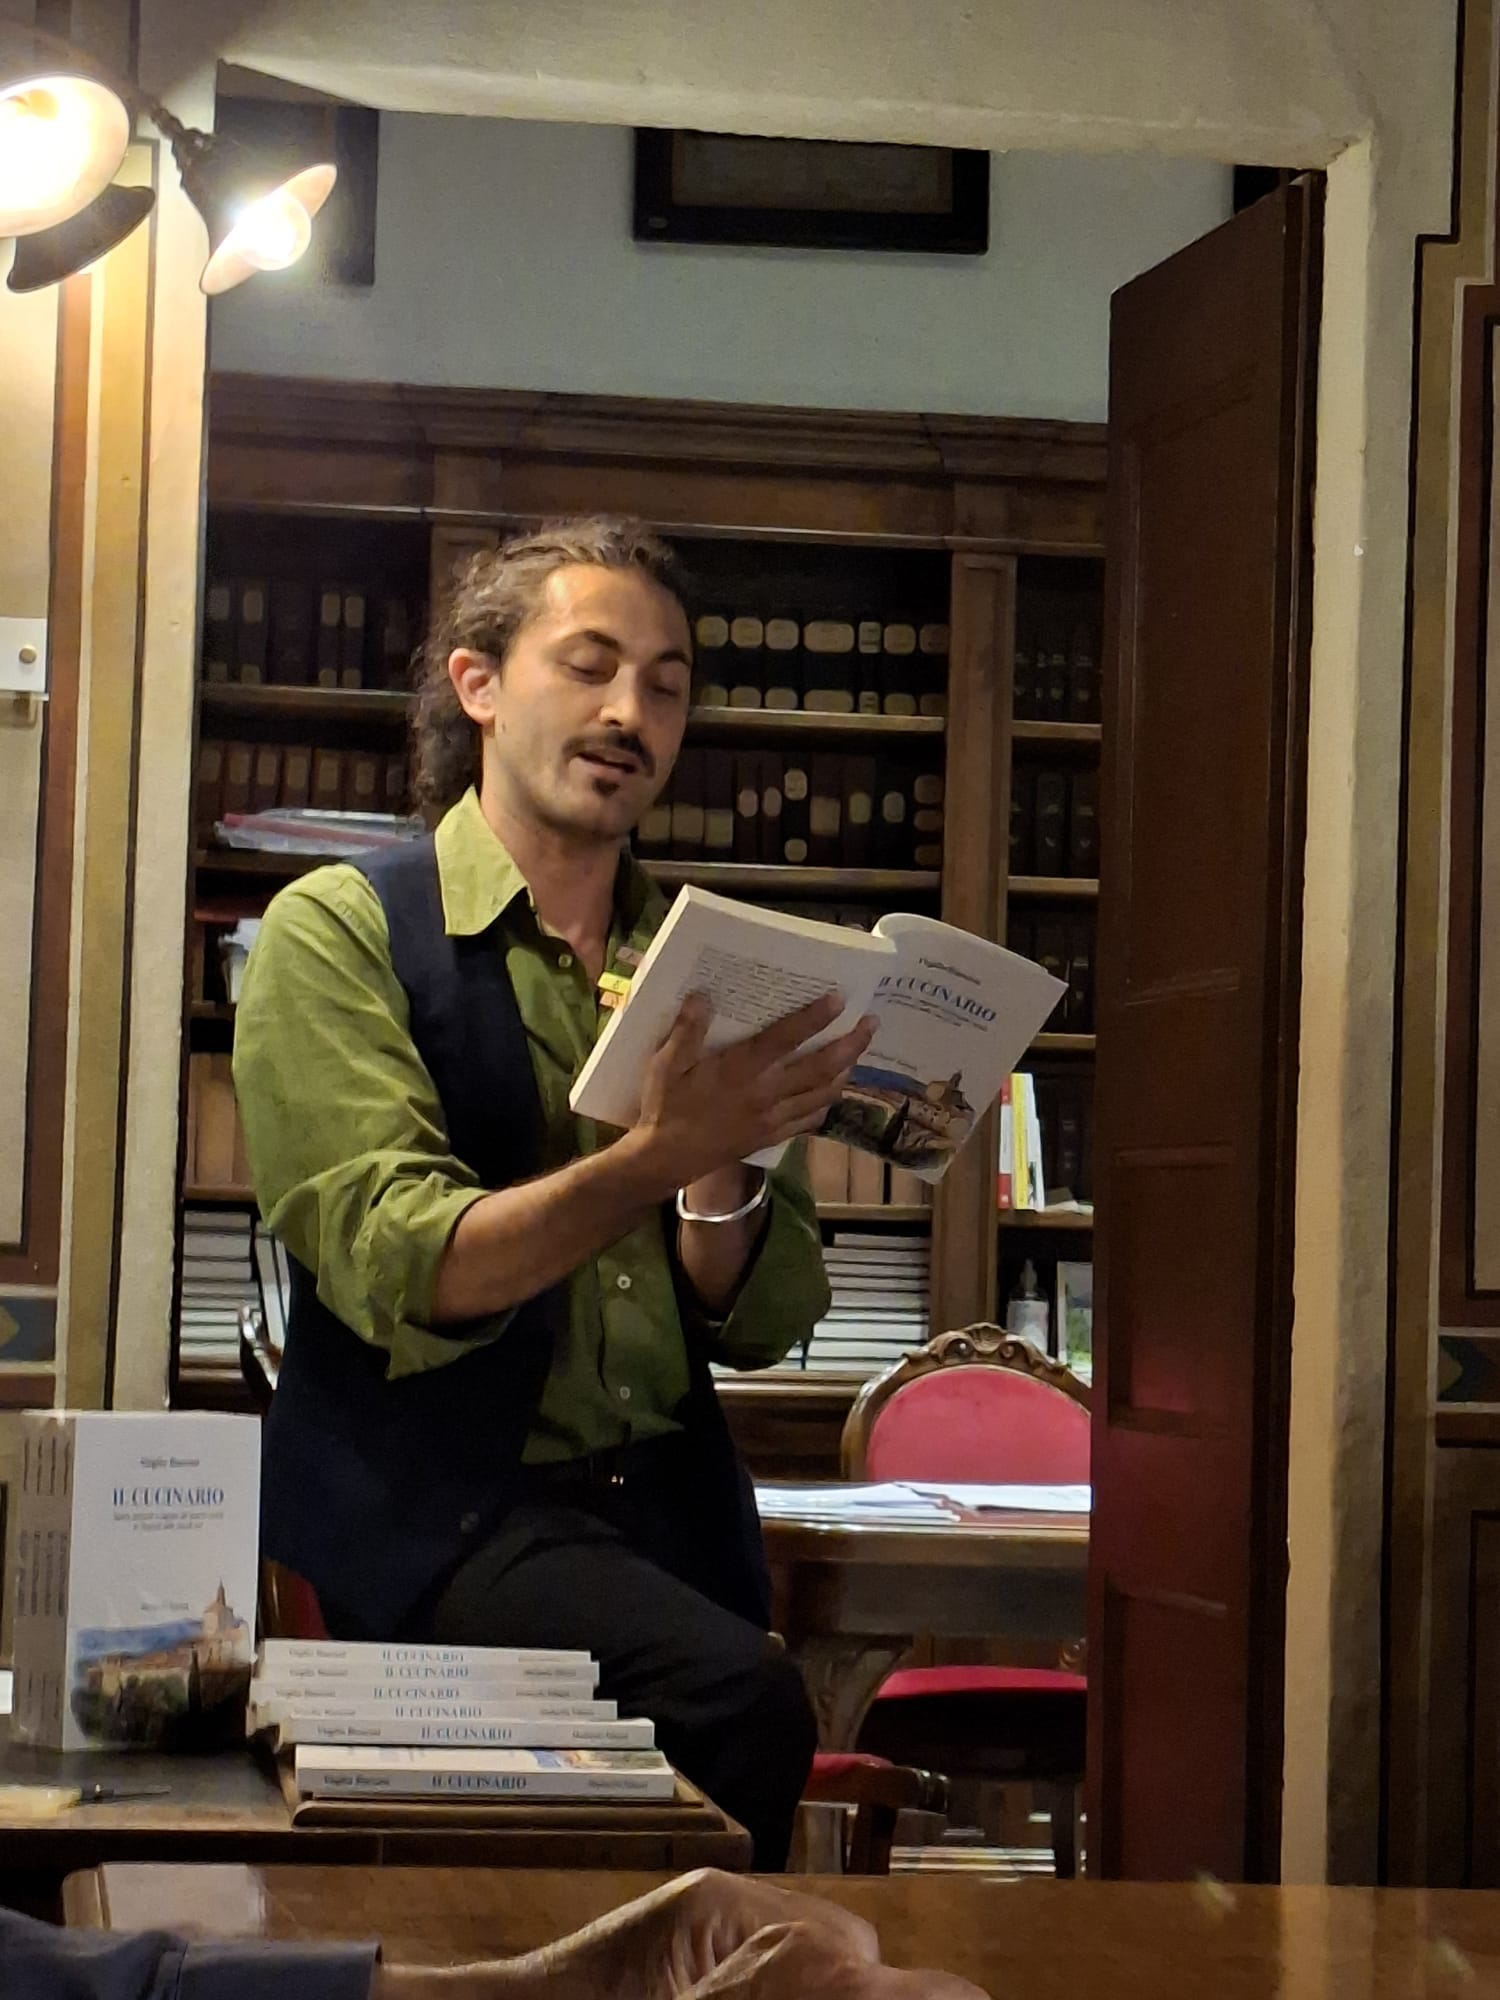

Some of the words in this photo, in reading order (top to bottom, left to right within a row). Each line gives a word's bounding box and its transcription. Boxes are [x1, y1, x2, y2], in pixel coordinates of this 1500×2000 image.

[895, 977, 997, 1022] CUCINARIO
[113, 1487, 129, 1506] IL
[131, 1487, 225, 1506] CUCINARIO
[436, 1727, 513, 1740] CUCINARIO
[448, 1775, 528, 1790] CUCINARIO
